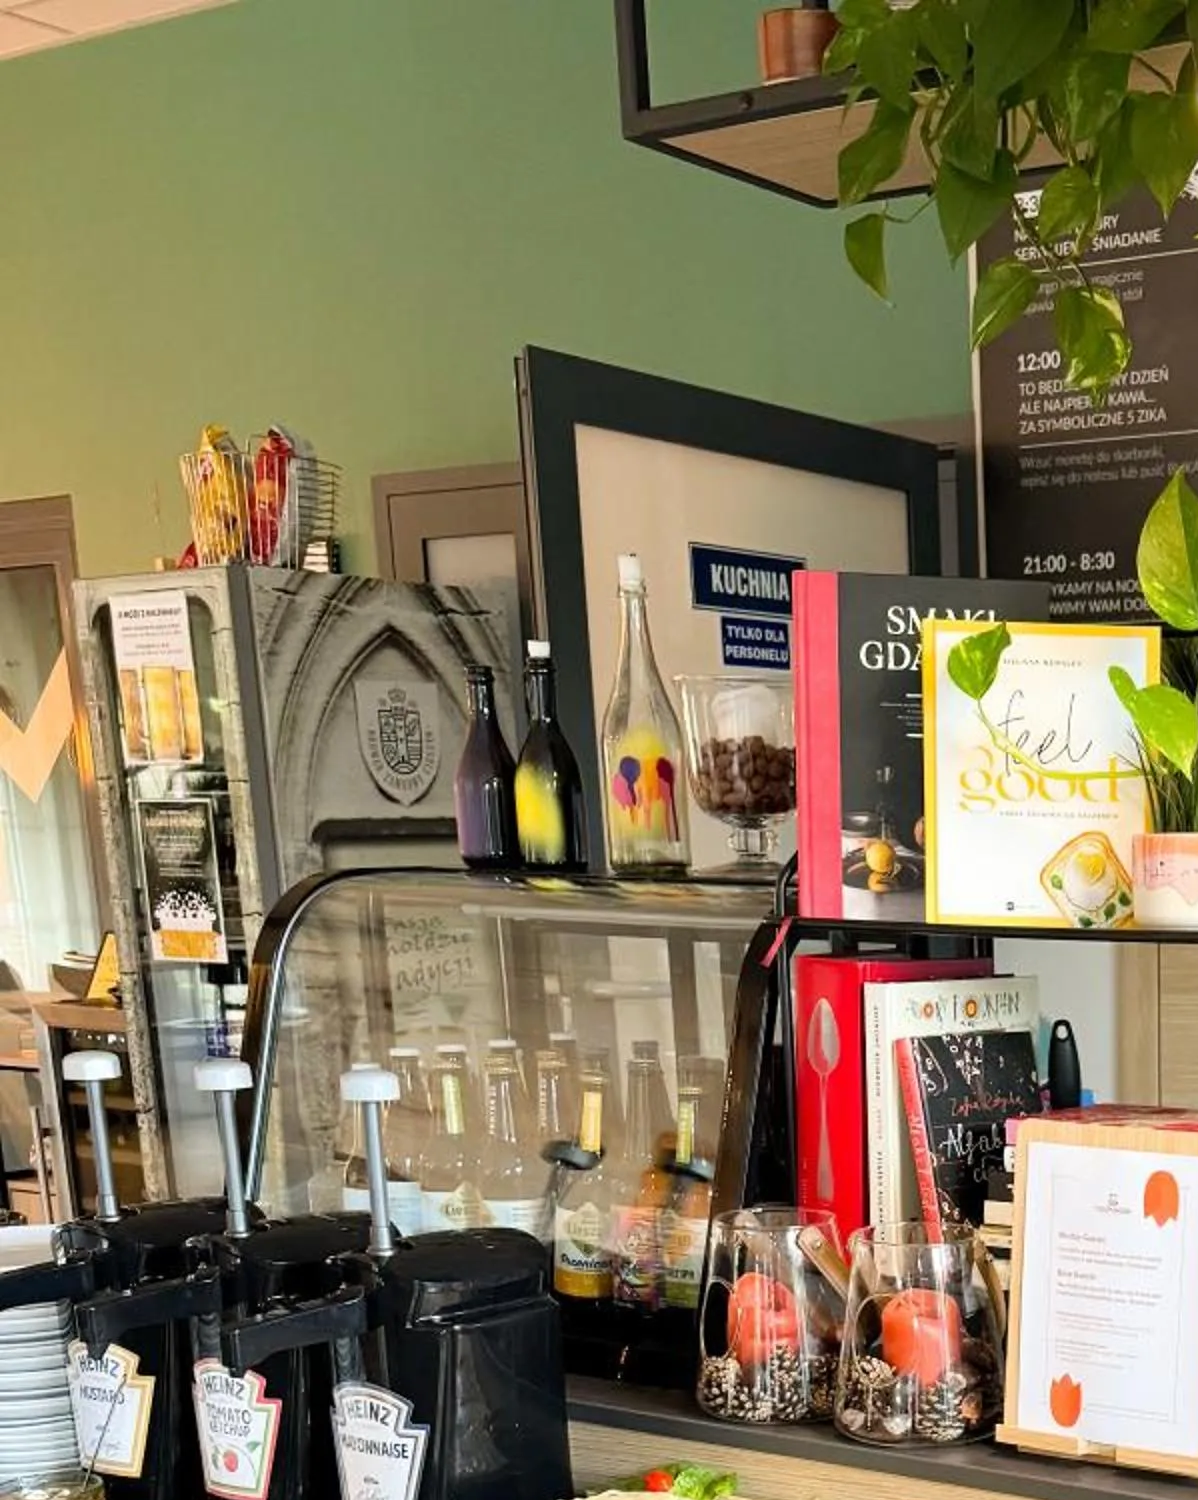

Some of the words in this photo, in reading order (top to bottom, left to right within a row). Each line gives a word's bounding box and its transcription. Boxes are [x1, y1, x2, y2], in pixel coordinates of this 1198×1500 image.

[1091, 227, 1164, 252] ŚNIADANIE
[1017, 350, 1061, 373] 12:00
[1019, 382, 1036, 397] TO
[1130, 365, 1169, 386] DZIEŃ
[1018, 399, 1041, 416] ALE
[1043, 394, 1105, 413] NAJPIER
[1018, 420, 1037, 435] ZA
[1037, 412, 1125, 433] SYMBOLICZNE
[1127, 411, 1136, 426] 5
[1138, 407, 1168, 424] ZIKA
[1023, 554, 1067, 575] 21:00
[1080, 551, 1116, 571] 8:30
[710, 563, 790, 602] KUCHNIA
[1051, 581, 1094, 597] YKAMY
[1094, 580, 1114, 595] NA
[1050, 600, 1088, 615] WIMY
[1088, 598, 1122, 613] WAM
[1123, 597, 1152, 612] DOB
[725, 625, 763, 642] TYLKO
[764, 629, 786, 643] DLA
[725, 644, 789, 663] PERSONELU
[859, 640, 923, 671] GD
[998, 689, 1093, 778] feel
[959, 745, 1121, 813] good
[939, 1123, 1004, 1166] Alfab
[78, 1355, 120, 1377] HEINZ
[204, 1375, 245, 1401] HEINZ
[206, 1403, 252, 1425] TOMATO
[345, 1400, 392, 1427] HEINZ
[209, 1419, 251, 1437] KETCHUP
